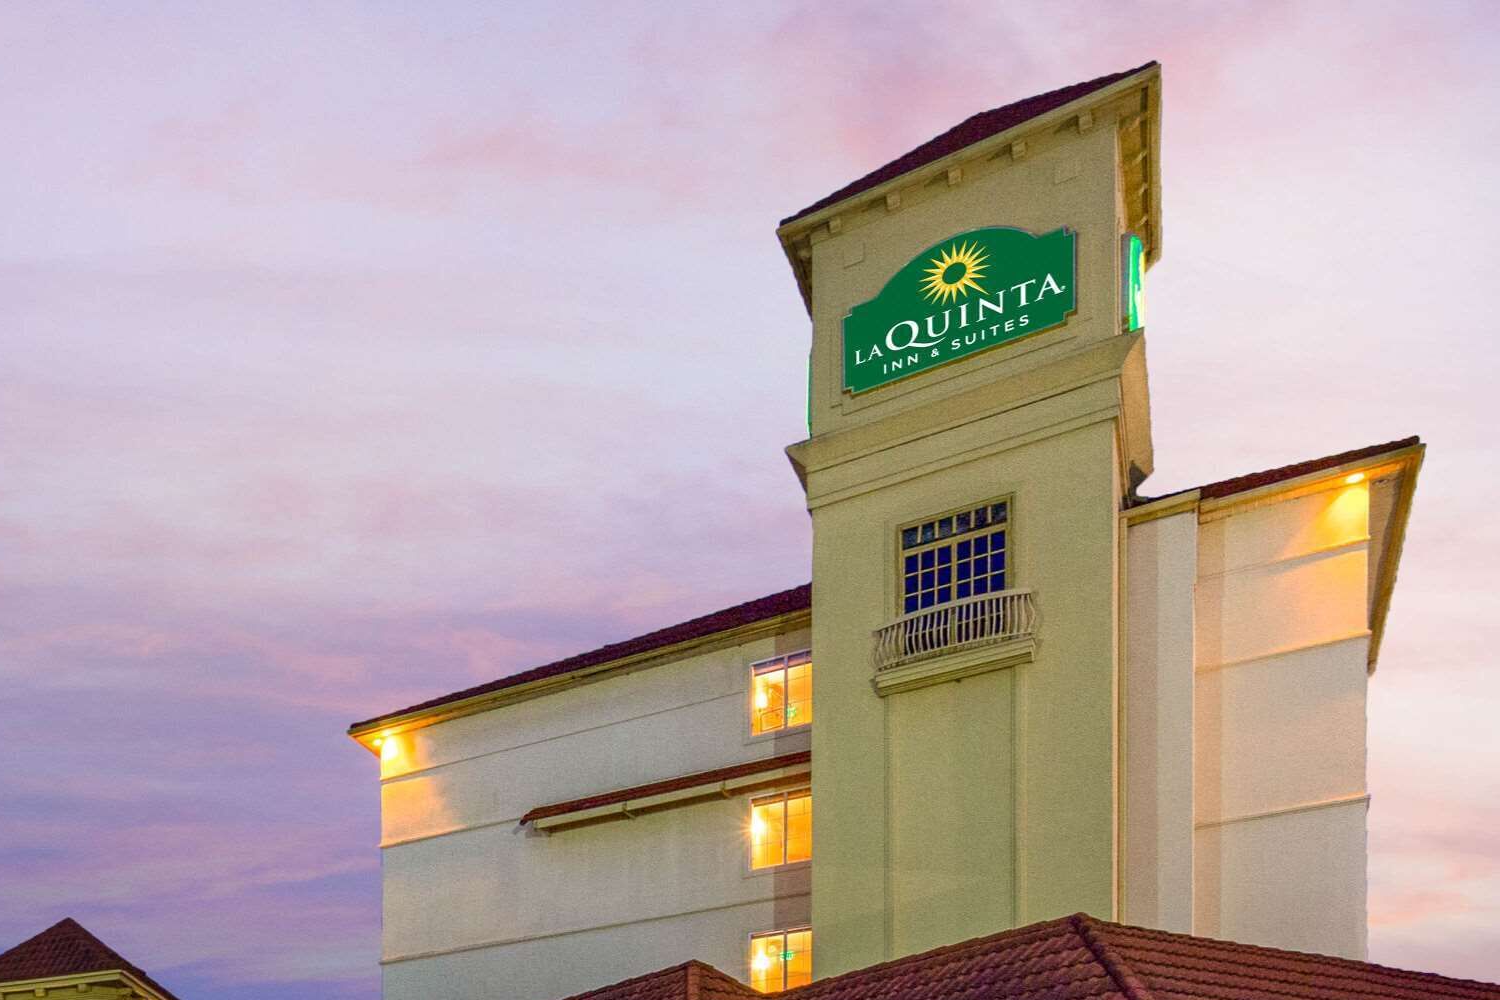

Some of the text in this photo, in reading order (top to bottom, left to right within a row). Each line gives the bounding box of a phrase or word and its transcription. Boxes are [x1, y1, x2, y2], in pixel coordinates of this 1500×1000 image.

[855, 273, 1064, 365] LA QUINTA
[883, 315, 1029, 375] INN & SUITES
